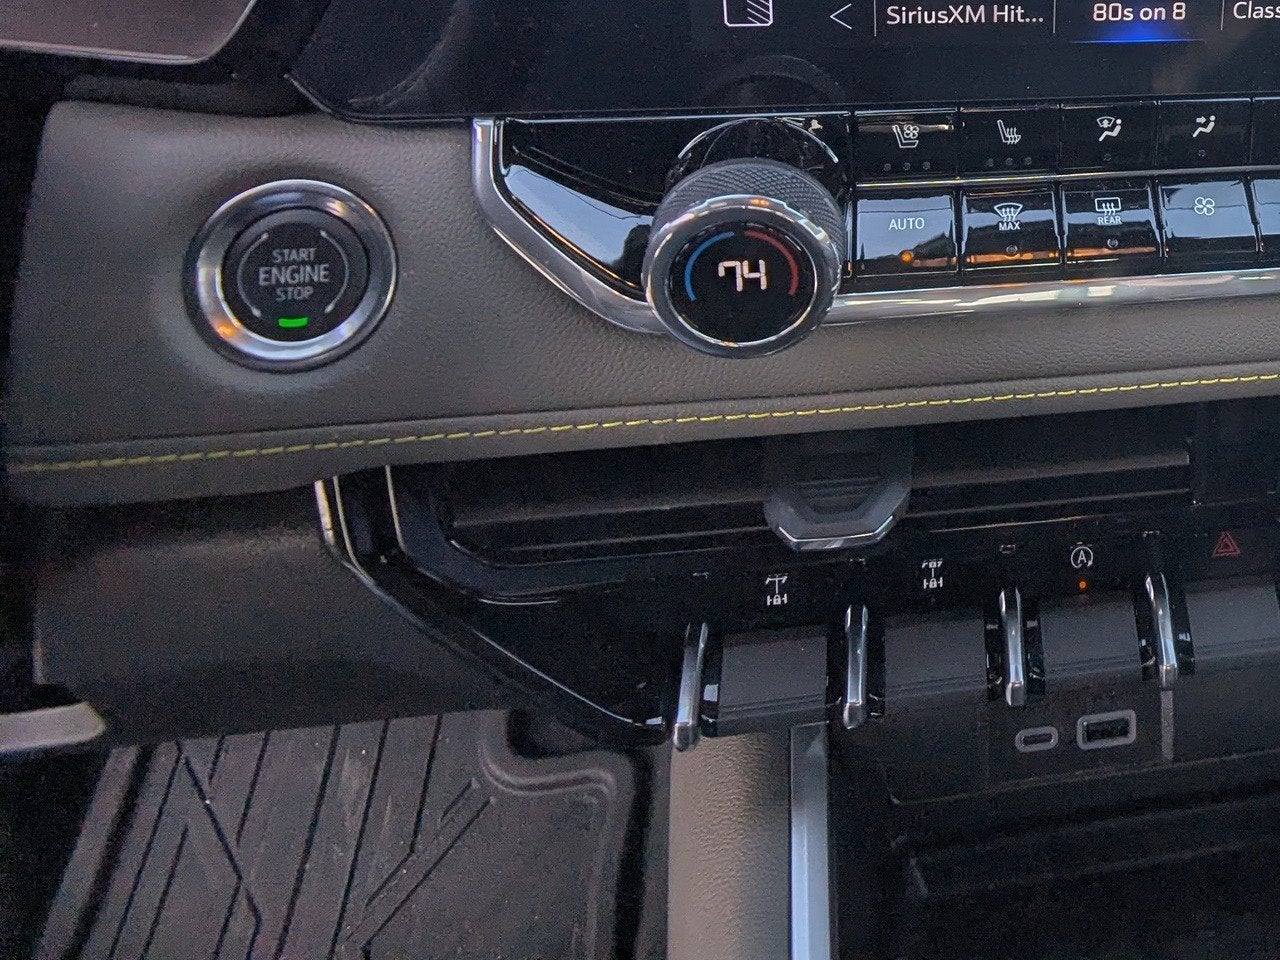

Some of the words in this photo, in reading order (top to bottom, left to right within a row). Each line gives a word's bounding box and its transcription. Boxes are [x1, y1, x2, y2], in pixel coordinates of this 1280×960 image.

[886, 4, 986, 25] SiriusXM
[1092, 2, 1134, 22] 80s
[1139, 8, 1166, 22] on
[1171, 2, 1187, 21] 8
[888, 217, 926, 231] AUTO
[998, 220, 1022, 232] MAX
[1097, 214, 1123, 227] REAR
[272, 247, 317, 264] START
[258, 264, 331, 286] ENGINE
[717, 259, 767, 293] 74
[275, 286, 314, 303] STOP
